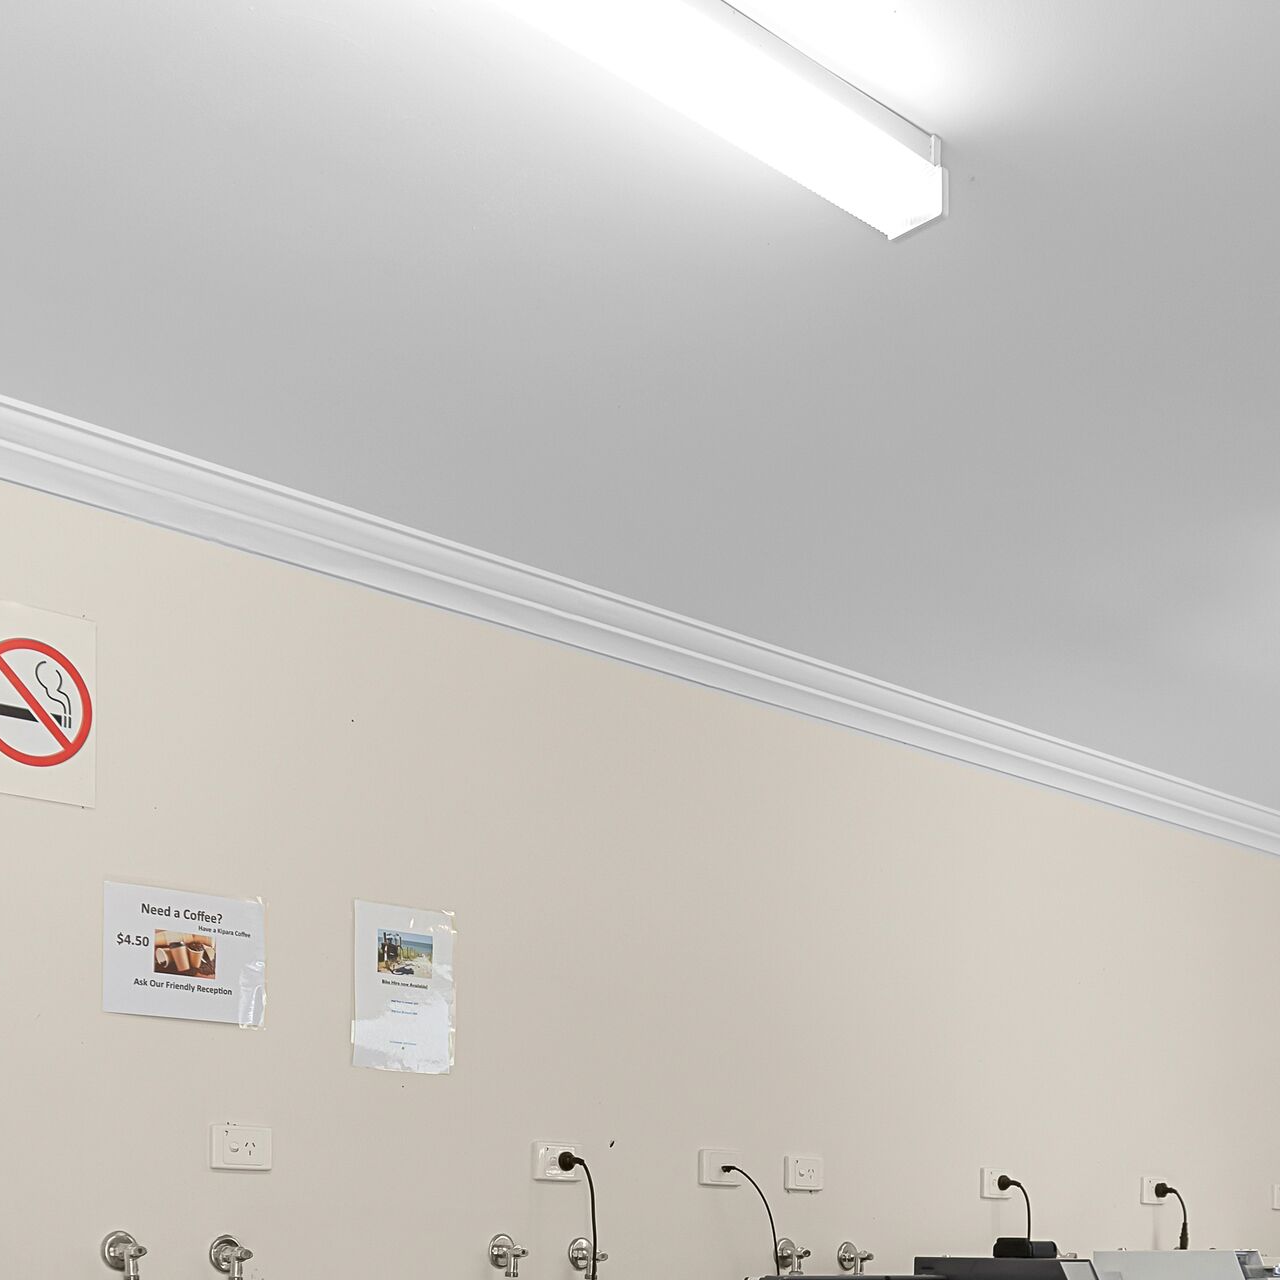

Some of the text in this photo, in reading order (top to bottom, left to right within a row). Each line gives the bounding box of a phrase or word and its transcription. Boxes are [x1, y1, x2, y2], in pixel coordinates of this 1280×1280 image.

[141, 902, 223, 924] Need a Coffee?
[116, 932, 150, 947] $4.50
[198, 925, 212, 933] Have
[235, 930, 251, 938] Coffee
[133, 978, 233, 995] Ask Our Friendly Reception
